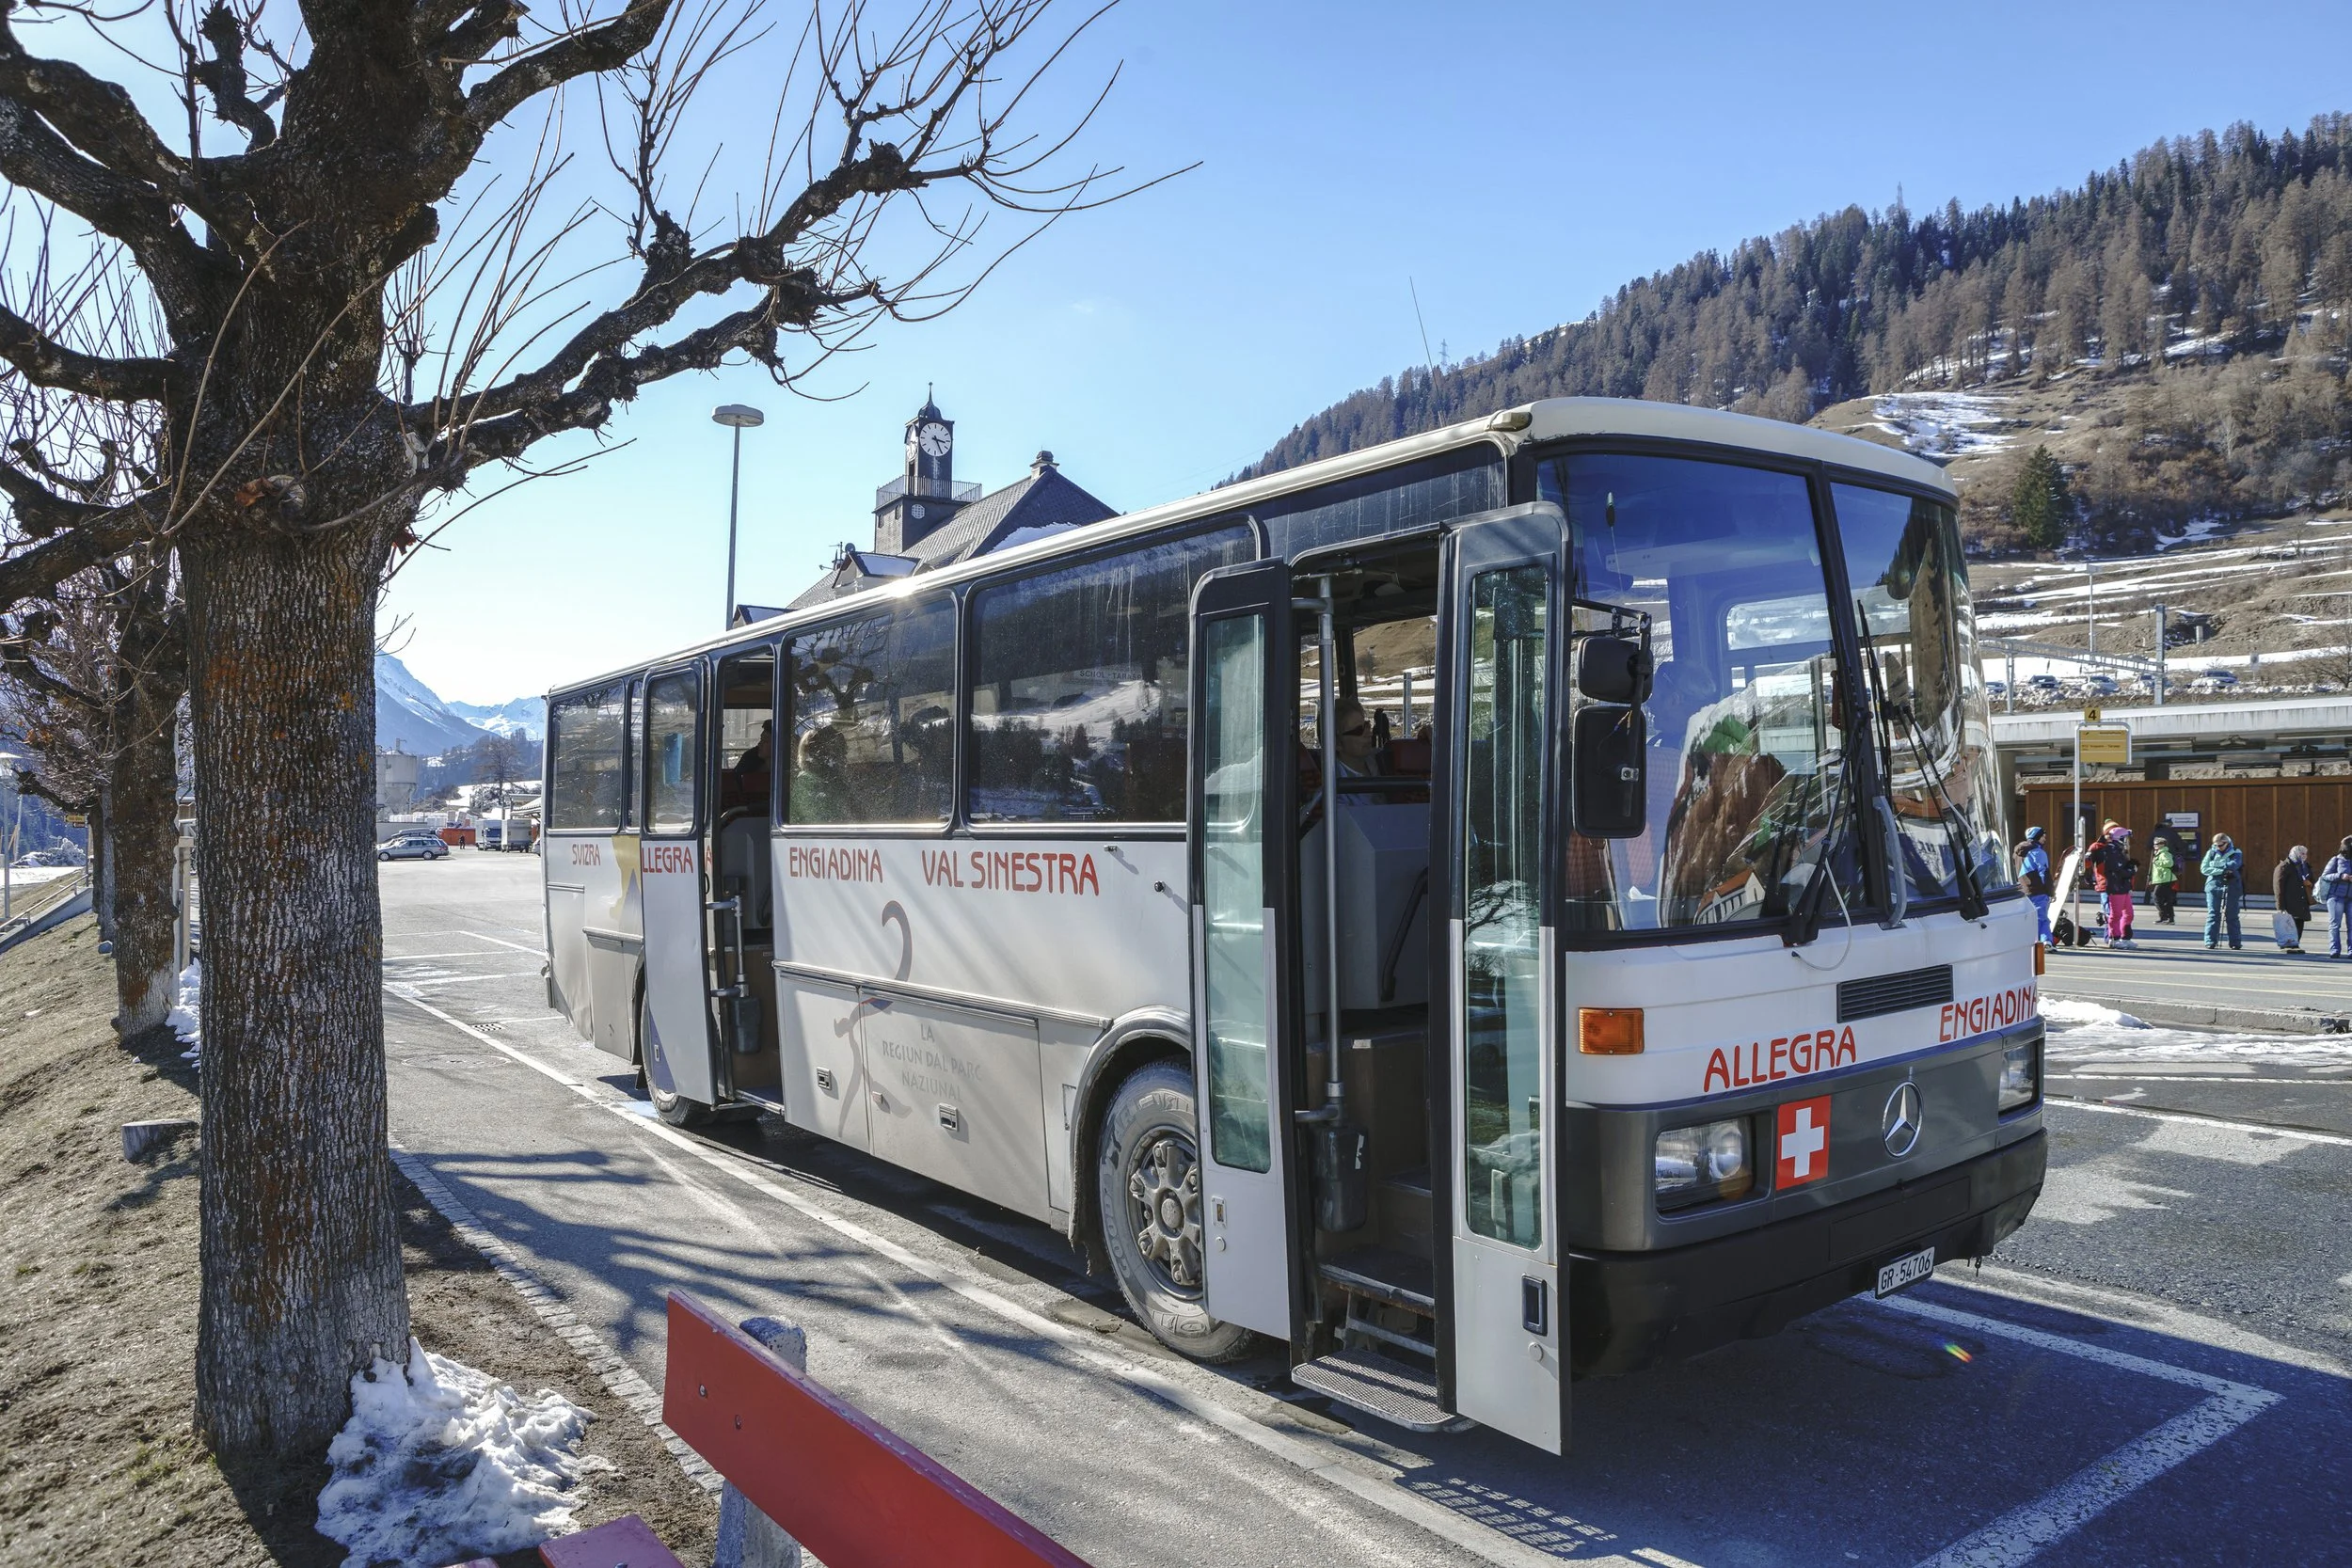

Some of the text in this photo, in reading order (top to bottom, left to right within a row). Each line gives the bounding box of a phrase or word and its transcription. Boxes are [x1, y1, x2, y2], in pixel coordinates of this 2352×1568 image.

[2088, 709, 2097, 721] 4
[572, 844, 601, 866] SVIZRA
[642, 846, 694, 874] LLEGRA
[789, 847, 883, 883] ENGIADINA
[921, 849, 1100, 896] VAL SINESTRA
[920, 1022, 935, 1043] LA
[882, 1039, 982, 1082] REGIUN DAL PARC
[1703, 1025, 1856, 1093] ALLEGRA
[901, 1069, 964, 1104] NAZIUNAL
